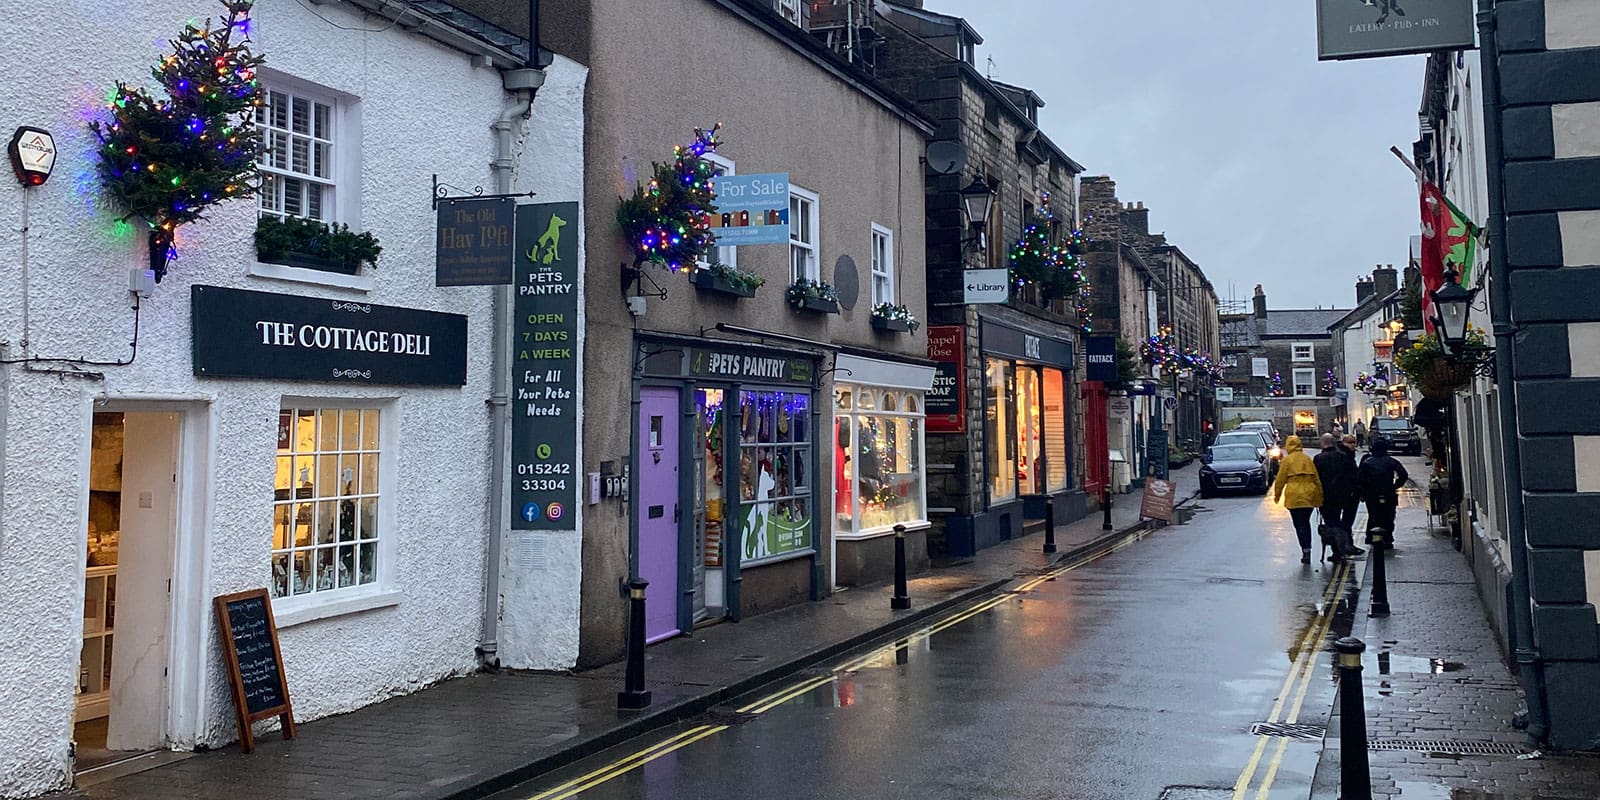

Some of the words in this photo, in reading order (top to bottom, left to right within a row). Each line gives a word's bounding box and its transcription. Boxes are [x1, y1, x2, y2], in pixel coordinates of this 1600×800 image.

[1349, 23, 1384, 33] EATERY
[1394, 20, 1412, 29] PUB
[1422, 17, 1439, 27] INN
[721, 181, 747, 197] For
[751, 179, 784, 196] Sale
[455, 208, 475, 223] The
[477, 208, 496, 223] Old
[441, 227, 474, 254] Hay
[480, 224, 511, 248] Loft
[529, 272, 563, 283] PETS
[519, 283, 572, 296] PANTRY
[976, 283, 1005, 292] Library
[528, 313, 564, 324] OPEN
[255, 321, 295, 346] THE
[299, 325, 389, 353] COTTAGE
[391, 333, 431, 356] DELI
[522, 332, 530, 342] 7
[535, 331, 568, 342] DAYS
[520, 350, 529, 360] A
[532, 348, 571, 359] WEEK
[1088, 354, 1114, 364] FATFACE
[712, 353, 740, 375] PETS
[743, 356, 785, 378] PANTRY
[524, 370, 541, 384] For
[545, 369, 561, 383] All
[518, 388, 541, 400] Your
[545, 386, 571, 399] Pets
[527, 403, 561, 416] Needs
[518, 463, 570, 475] 015242
[522, 479, 566, 491] 33304
